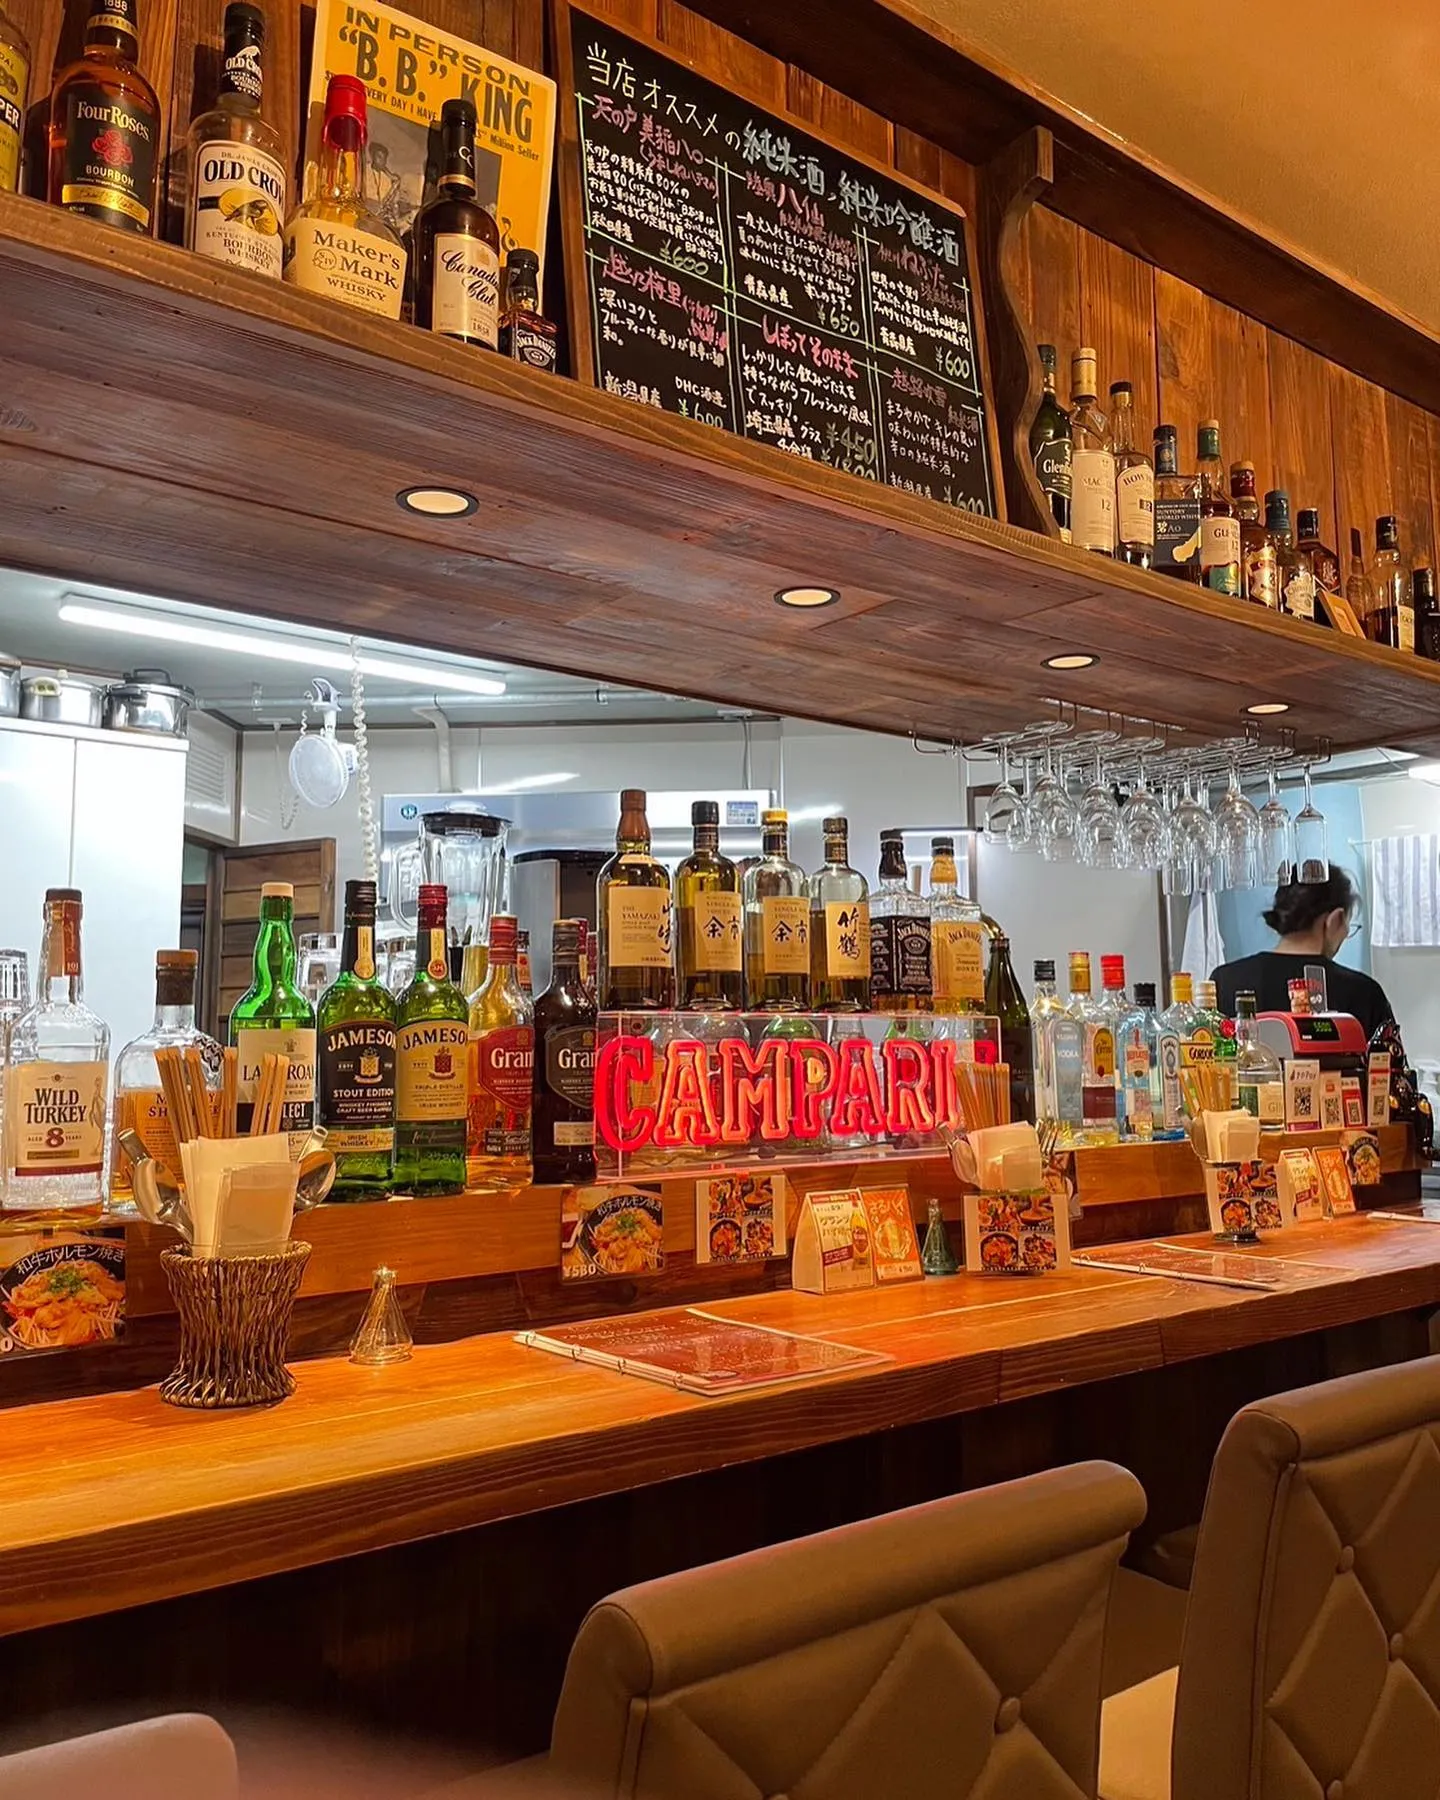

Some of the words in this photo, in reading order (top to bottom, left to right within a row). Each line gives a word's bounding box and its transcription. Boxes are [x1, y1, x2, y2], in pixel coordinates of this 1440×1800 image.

[346, 6, 380, 34] IN
[388, 26, 530, 96] PERSON
[366, 87, 389, 105] VERY
[390, 96, 407, 110] DAY
[417, 105, 438, 123] HAVE
[460, 73, 533, 144] KING
[85, 165, 134, 187] BOURBON
[203, 159, 245, 183] OLD
[223, 239, 274, 262] BOURBON
[228, 248, 271, 271] WHISKEY
[313, 229, 401, 271] Maker's
[659, 238, 709, 275] ¥600
[339, 255, 399, 290] Mark
[326, 276, 387, 303] WHISKY
[461, 275, 496, 307] Club
[816, 302, 860, 337] ¥650
[934, 345, 970, 379] ¥600
[622, 912, 660, 920] YAMAZAKI
[34, 1087, 80, 1106] WILD
[333, 1087, 363, 1098] STOUT
[594, 1034, 962, 1152] CAMPARI
[23, 1102, 87, 1125] TURKEY
[281, 1102, 306, 1119] LECT
[45, 1127, 65, 1148] 8
[15, 1243, 126, 1276] 和牛ホルモン焼き
